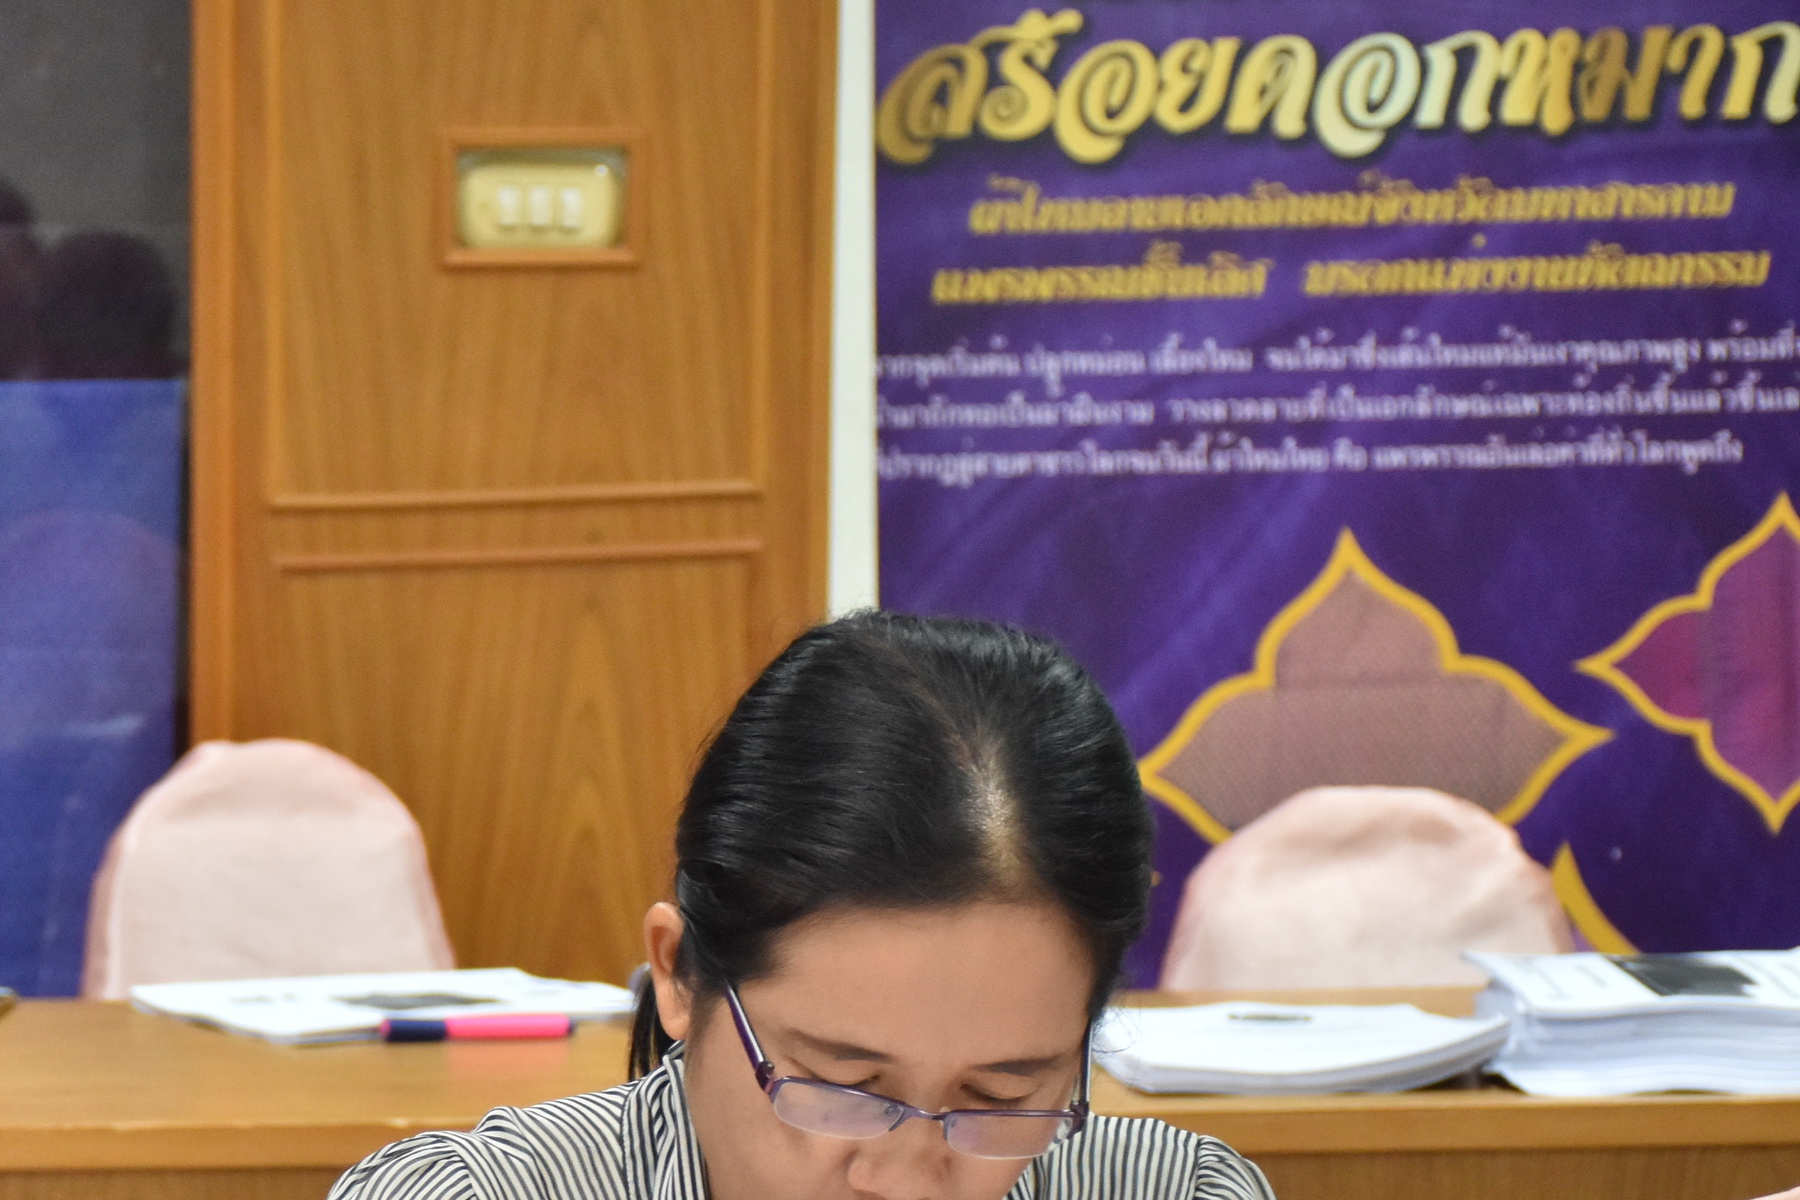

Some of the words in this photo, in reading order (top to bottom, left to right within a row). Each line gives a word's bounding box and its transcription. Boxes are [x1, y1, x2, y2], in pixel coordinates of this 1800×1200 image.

[876, 8, 1800, 163] สร้อยดอกหมาก
